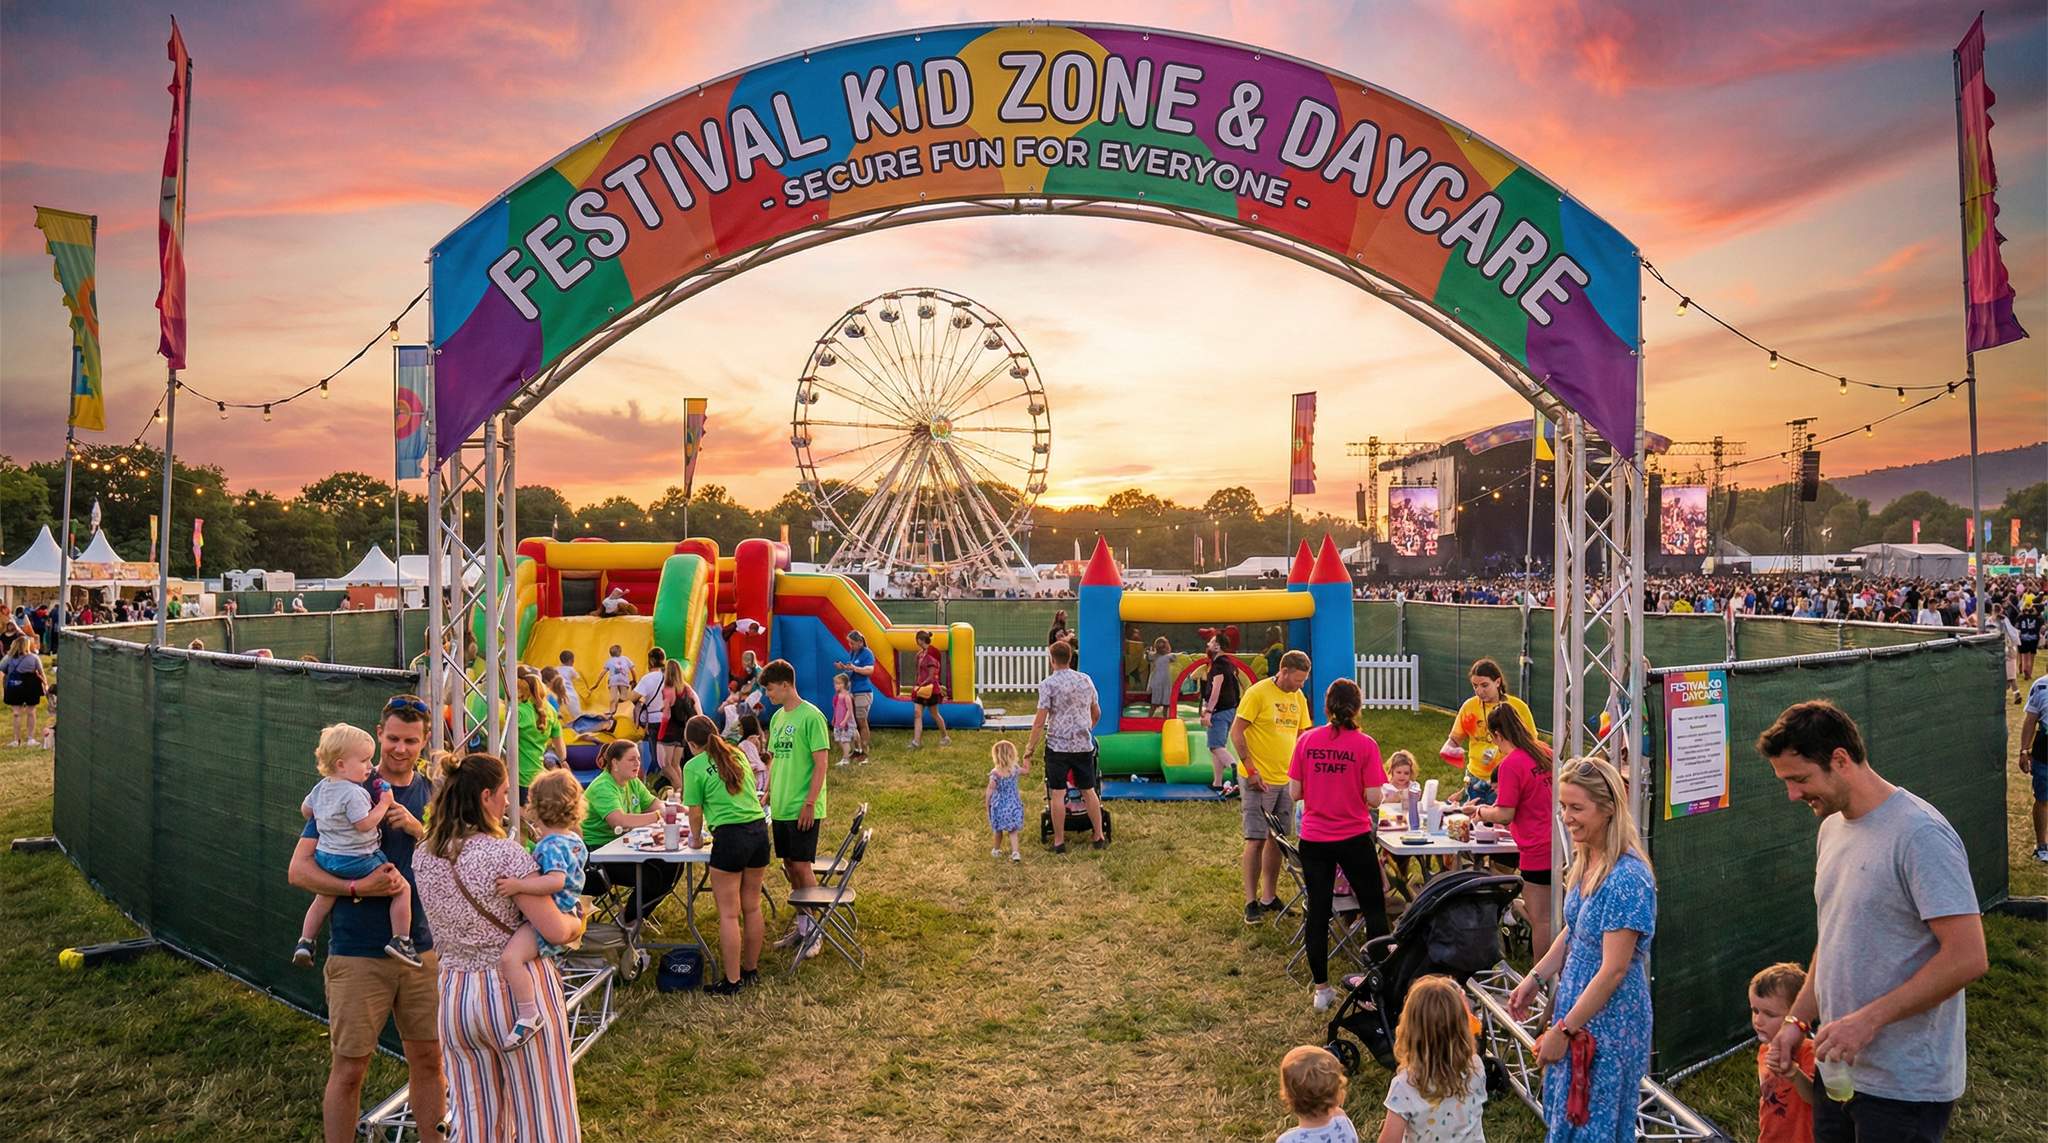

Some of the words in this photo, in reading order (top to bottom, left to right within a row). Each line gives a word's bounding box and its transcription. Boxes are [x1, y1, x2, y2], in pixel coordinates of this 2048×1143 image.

[488, 92, 830, 322] FESTIVAL
[842, 56, 974, 142] KID
[998, 50, 1204, 135] ZONE
[1217, 82, 1266, 150] &
[1279, 97, 1591, 328] DAYCARE
[787, 146, 923, 208] SECURE
[930, 137, 1006, 169] FUN
[1015, 136, 1089, 167] FOR
[1099, 141, 1292, 208] EVERYONE
[1306, 749, 1355, 762] FESTIVAL
[1315, 763, 1347, 774] STAFF
